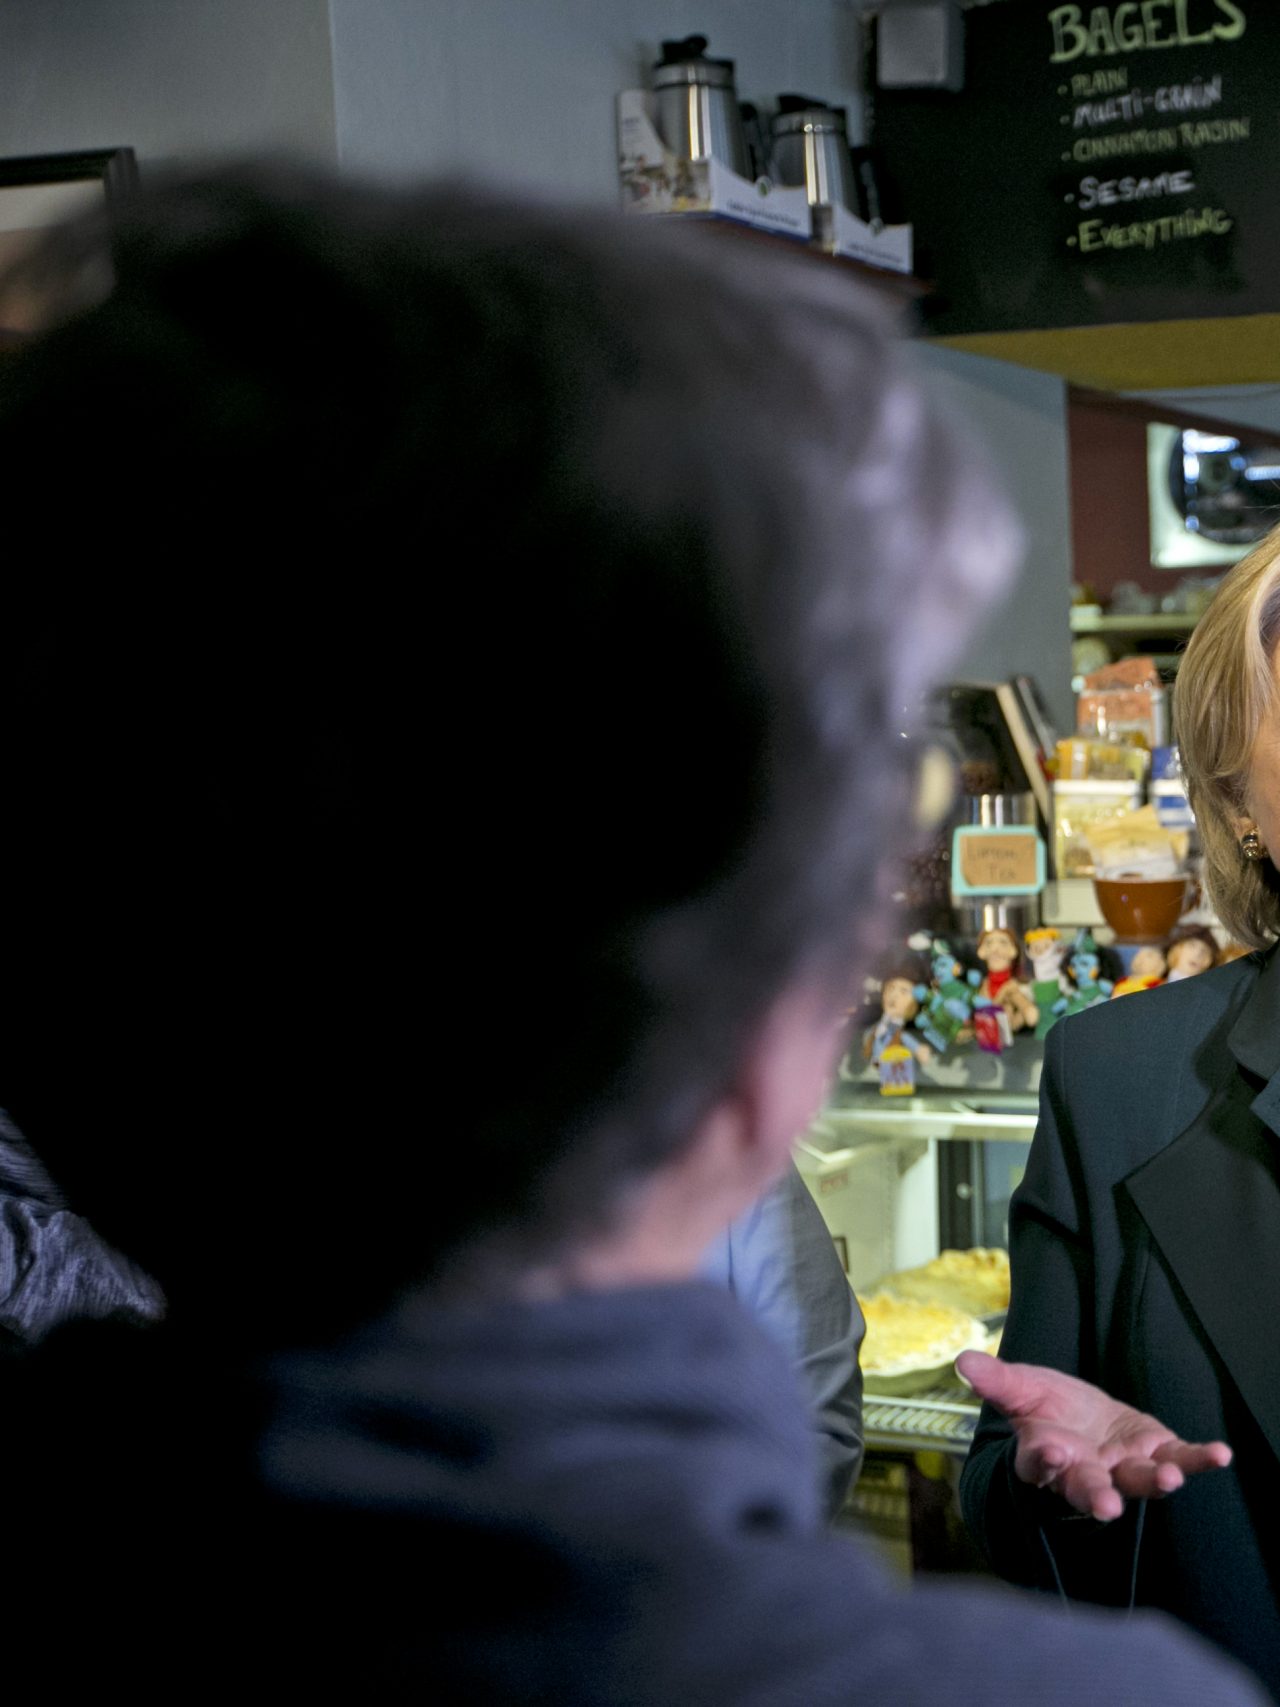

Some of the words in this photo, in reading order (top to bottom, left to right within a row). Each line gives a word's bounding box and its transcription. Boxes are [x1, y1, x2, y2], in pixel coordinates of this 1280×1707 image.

[1048, 0, 1247, 64] BAGELS
[1078, 170, 1197, 209] SESAME
[1077, 206, 1234, 252] EVERYTHING
